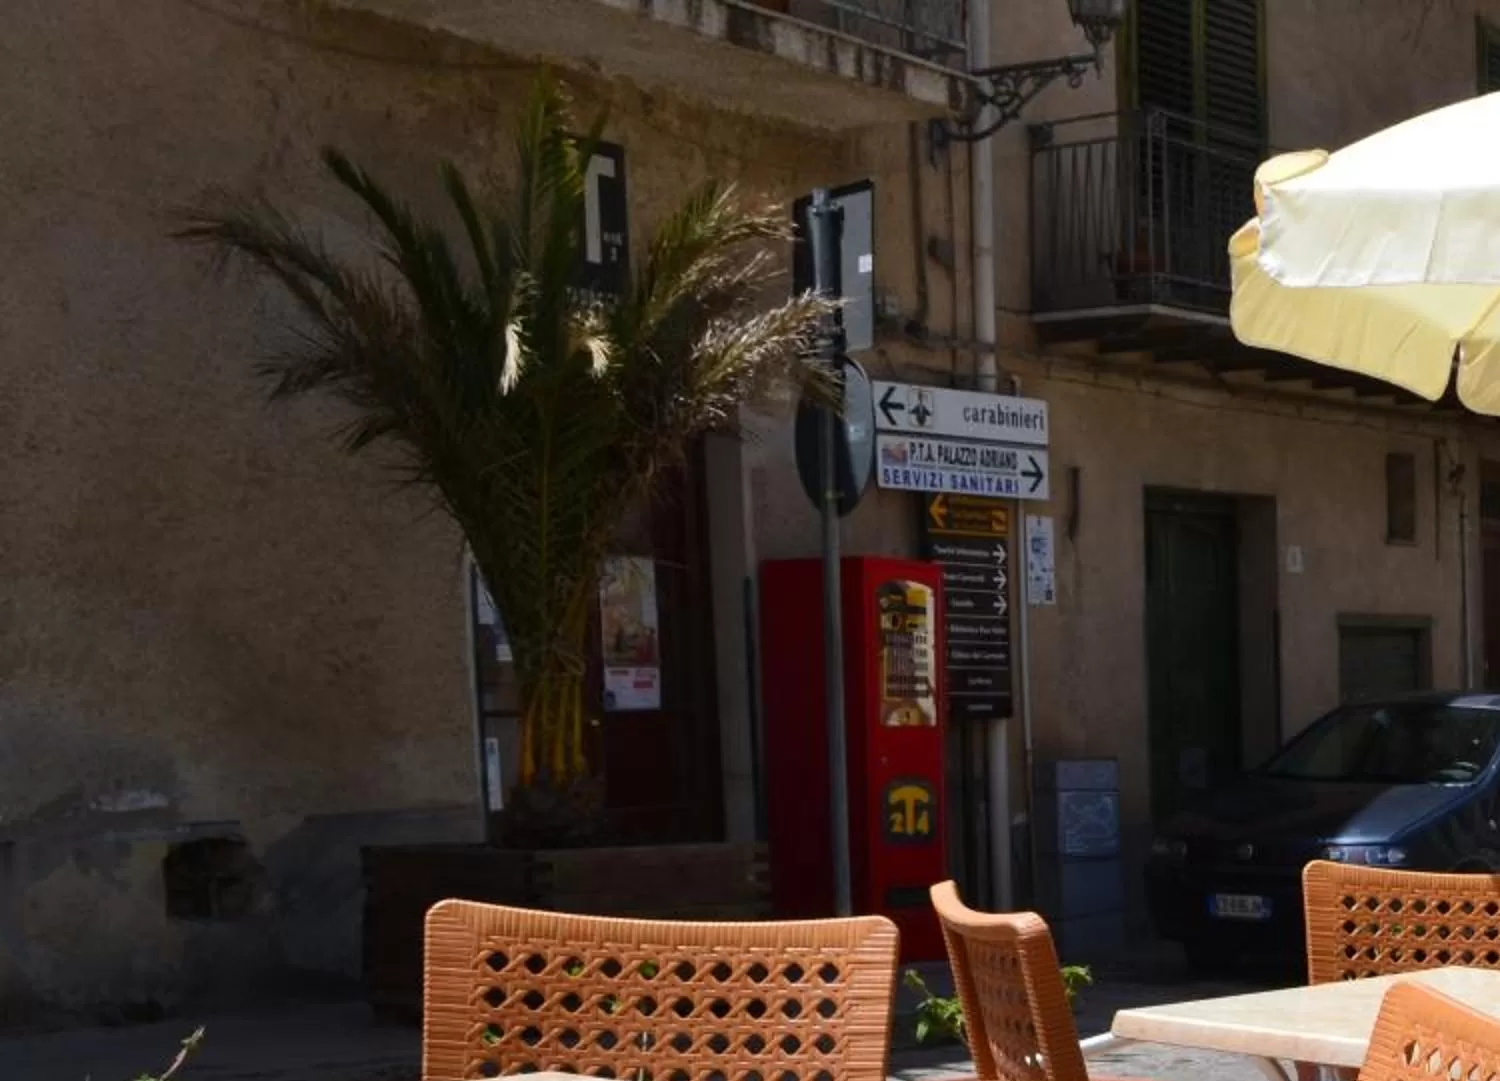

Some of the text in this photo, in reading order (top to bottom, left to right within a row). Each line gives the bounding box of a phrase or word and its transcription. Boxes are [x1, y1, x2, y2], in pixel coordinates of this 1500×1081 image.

[963, 403, 1045, 431] carabinieri
[937, 443, 977, 466] PALAZZO
[883, 467, 1019, 495] SERVIZI SANITARI
